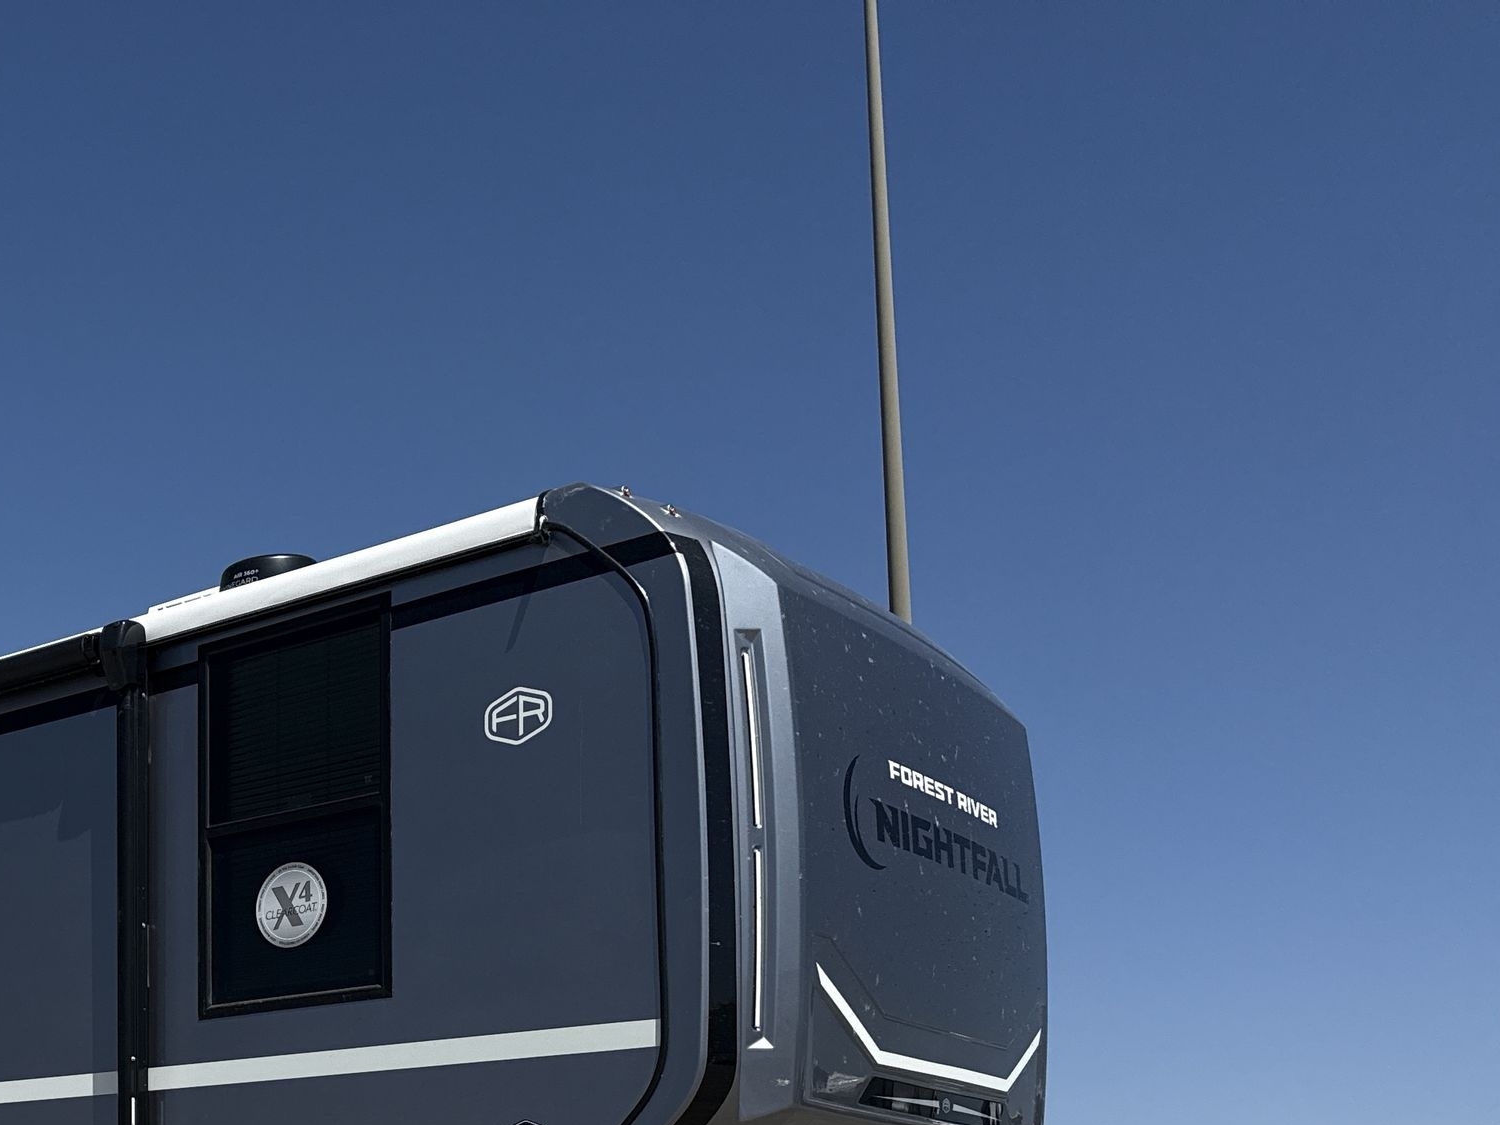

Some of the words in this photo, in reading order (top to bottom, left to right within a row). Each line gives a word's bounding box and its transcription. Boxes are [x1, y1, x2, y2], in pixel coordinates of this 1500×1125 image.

[233, 572, 243, 580] AIR
[888, 759, 955, 806] FOREST
[956, 790, 999, 829] RIVER
[869, 796, 1030, 905] NIGHTFALL
[264, 901, 318, 921] CLEARCOAT
